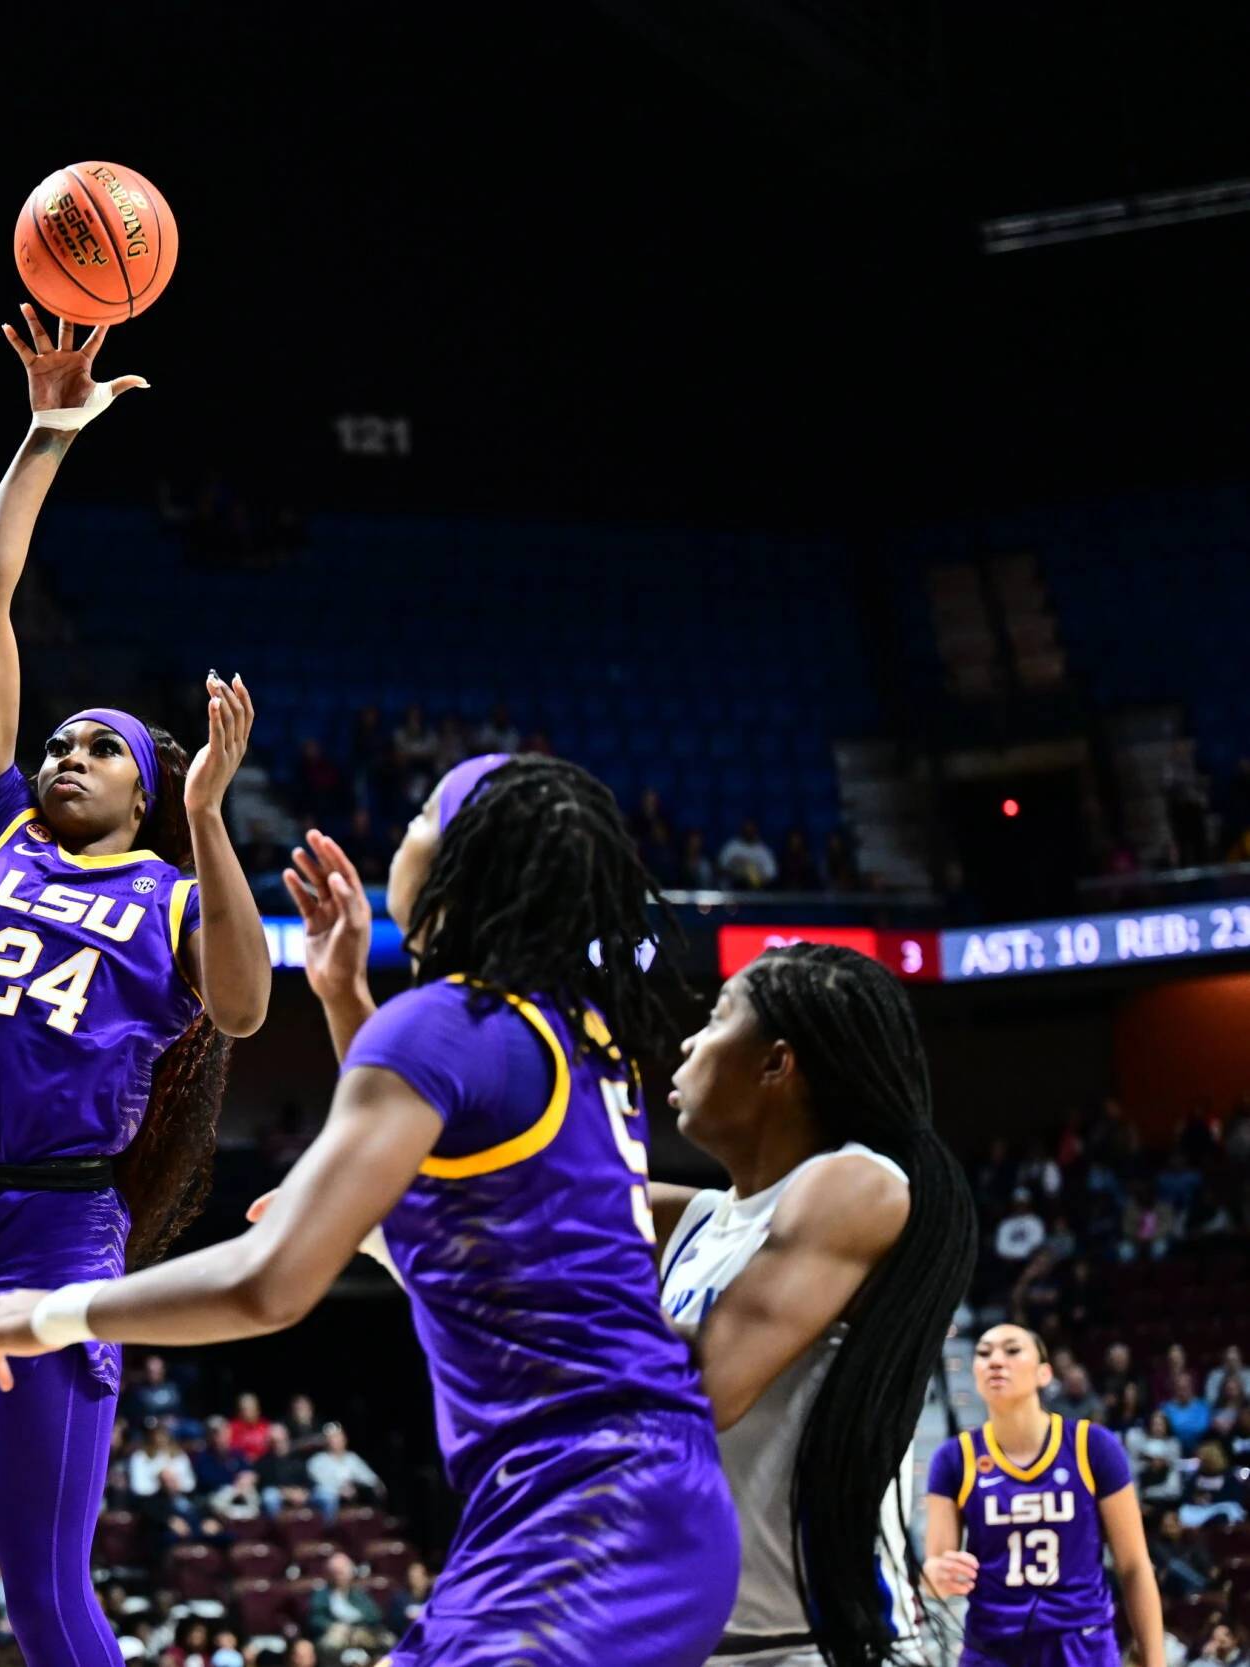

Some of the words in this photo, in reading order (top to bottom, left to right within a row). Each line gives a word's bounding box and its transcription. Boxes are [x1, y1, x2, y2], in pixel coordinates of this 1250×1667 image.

[57, 191, 109, 266] EGACY
[86, 166, 149, 259] SPALDING
[334, 414, 412, 454] 121
[960, 929, 1045, 976] AST:
[1054, 922, 1100, 966] 10
[1116, 913, 1200, 960] REB:
[984, 1491, 1075, 1526] LSU
[1005, 1529, 1060, 1587] 13
